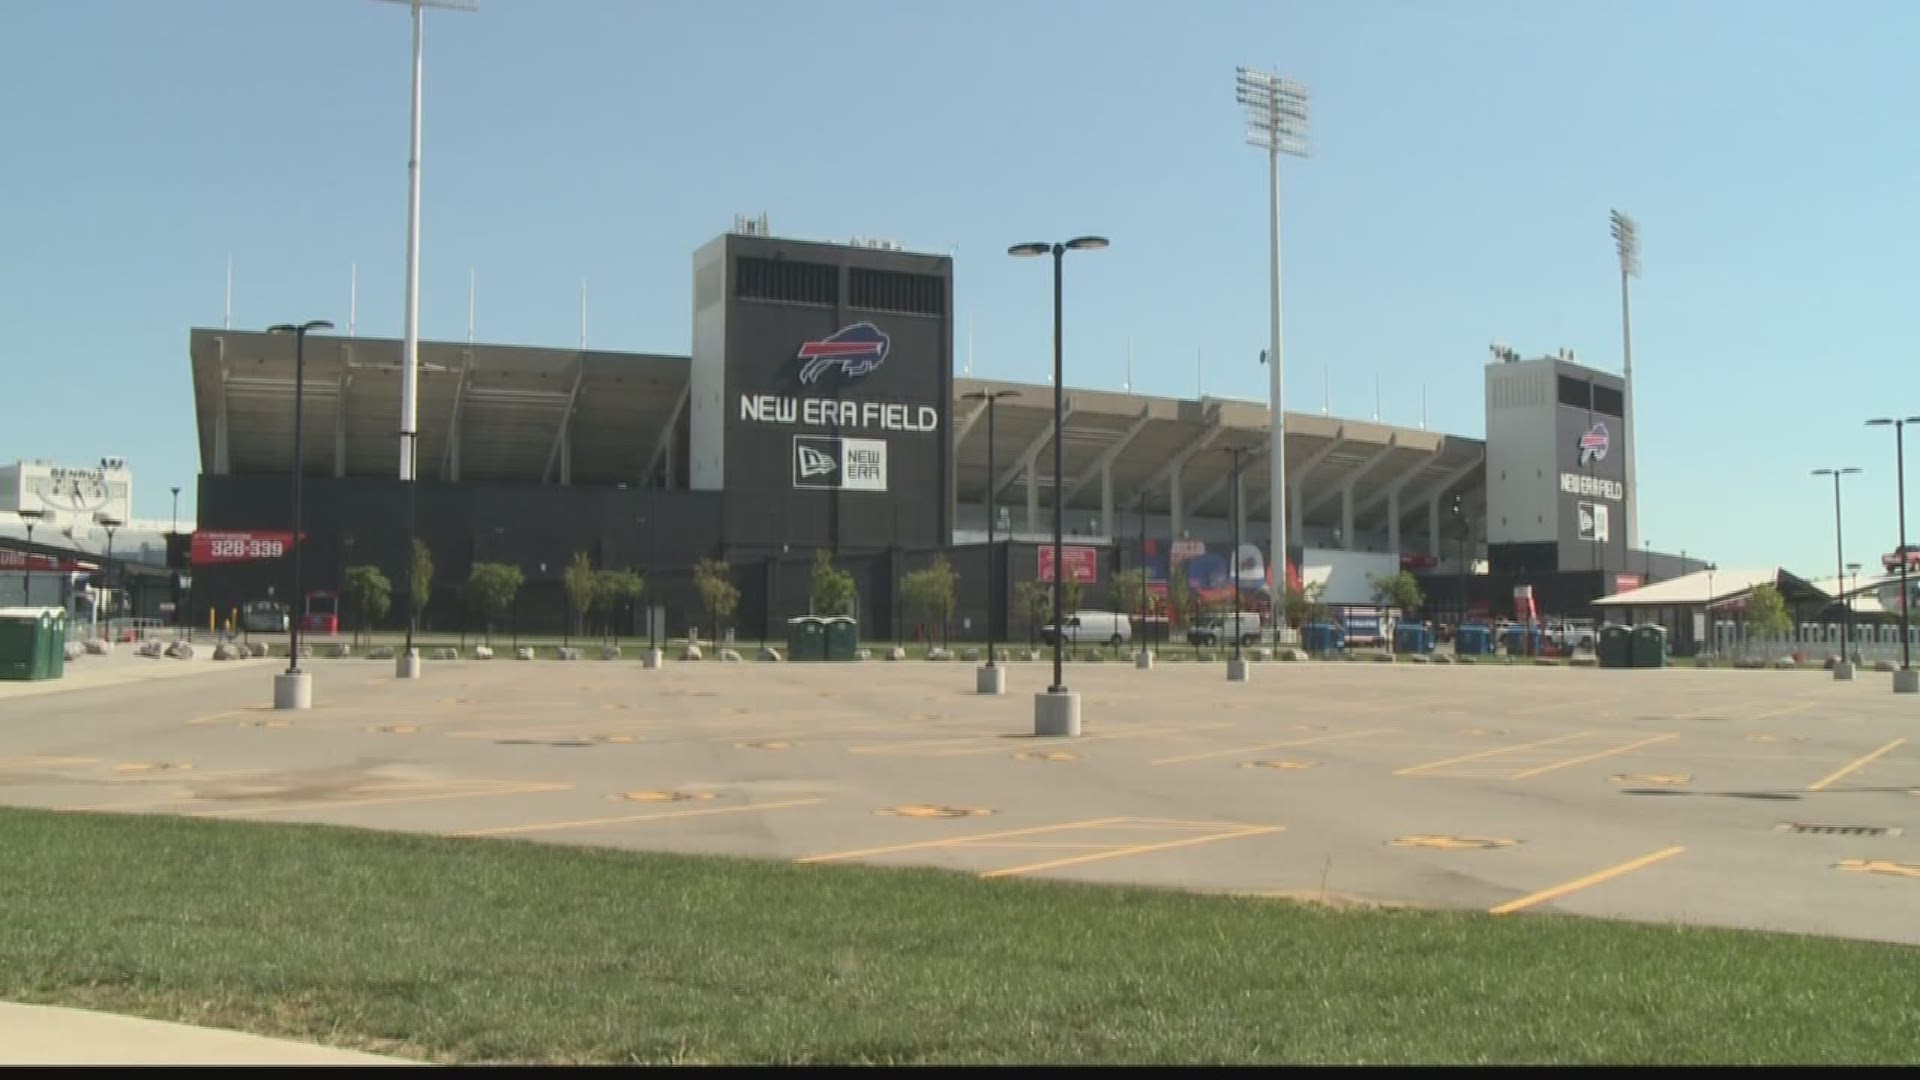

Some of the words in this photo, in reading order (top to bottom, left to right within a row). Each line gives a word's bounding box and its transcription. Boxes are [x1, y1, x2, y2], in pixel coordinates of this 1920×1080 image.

[740, 394, 797, 423] NEW
[803, 398, 857, 427] ERA
[863, 402, 938, 432] FIELD
[848, 450, 880, 463] NEW
[848, 466, 880, 479] ERA
[211, 540, 283, 558] 328-339
